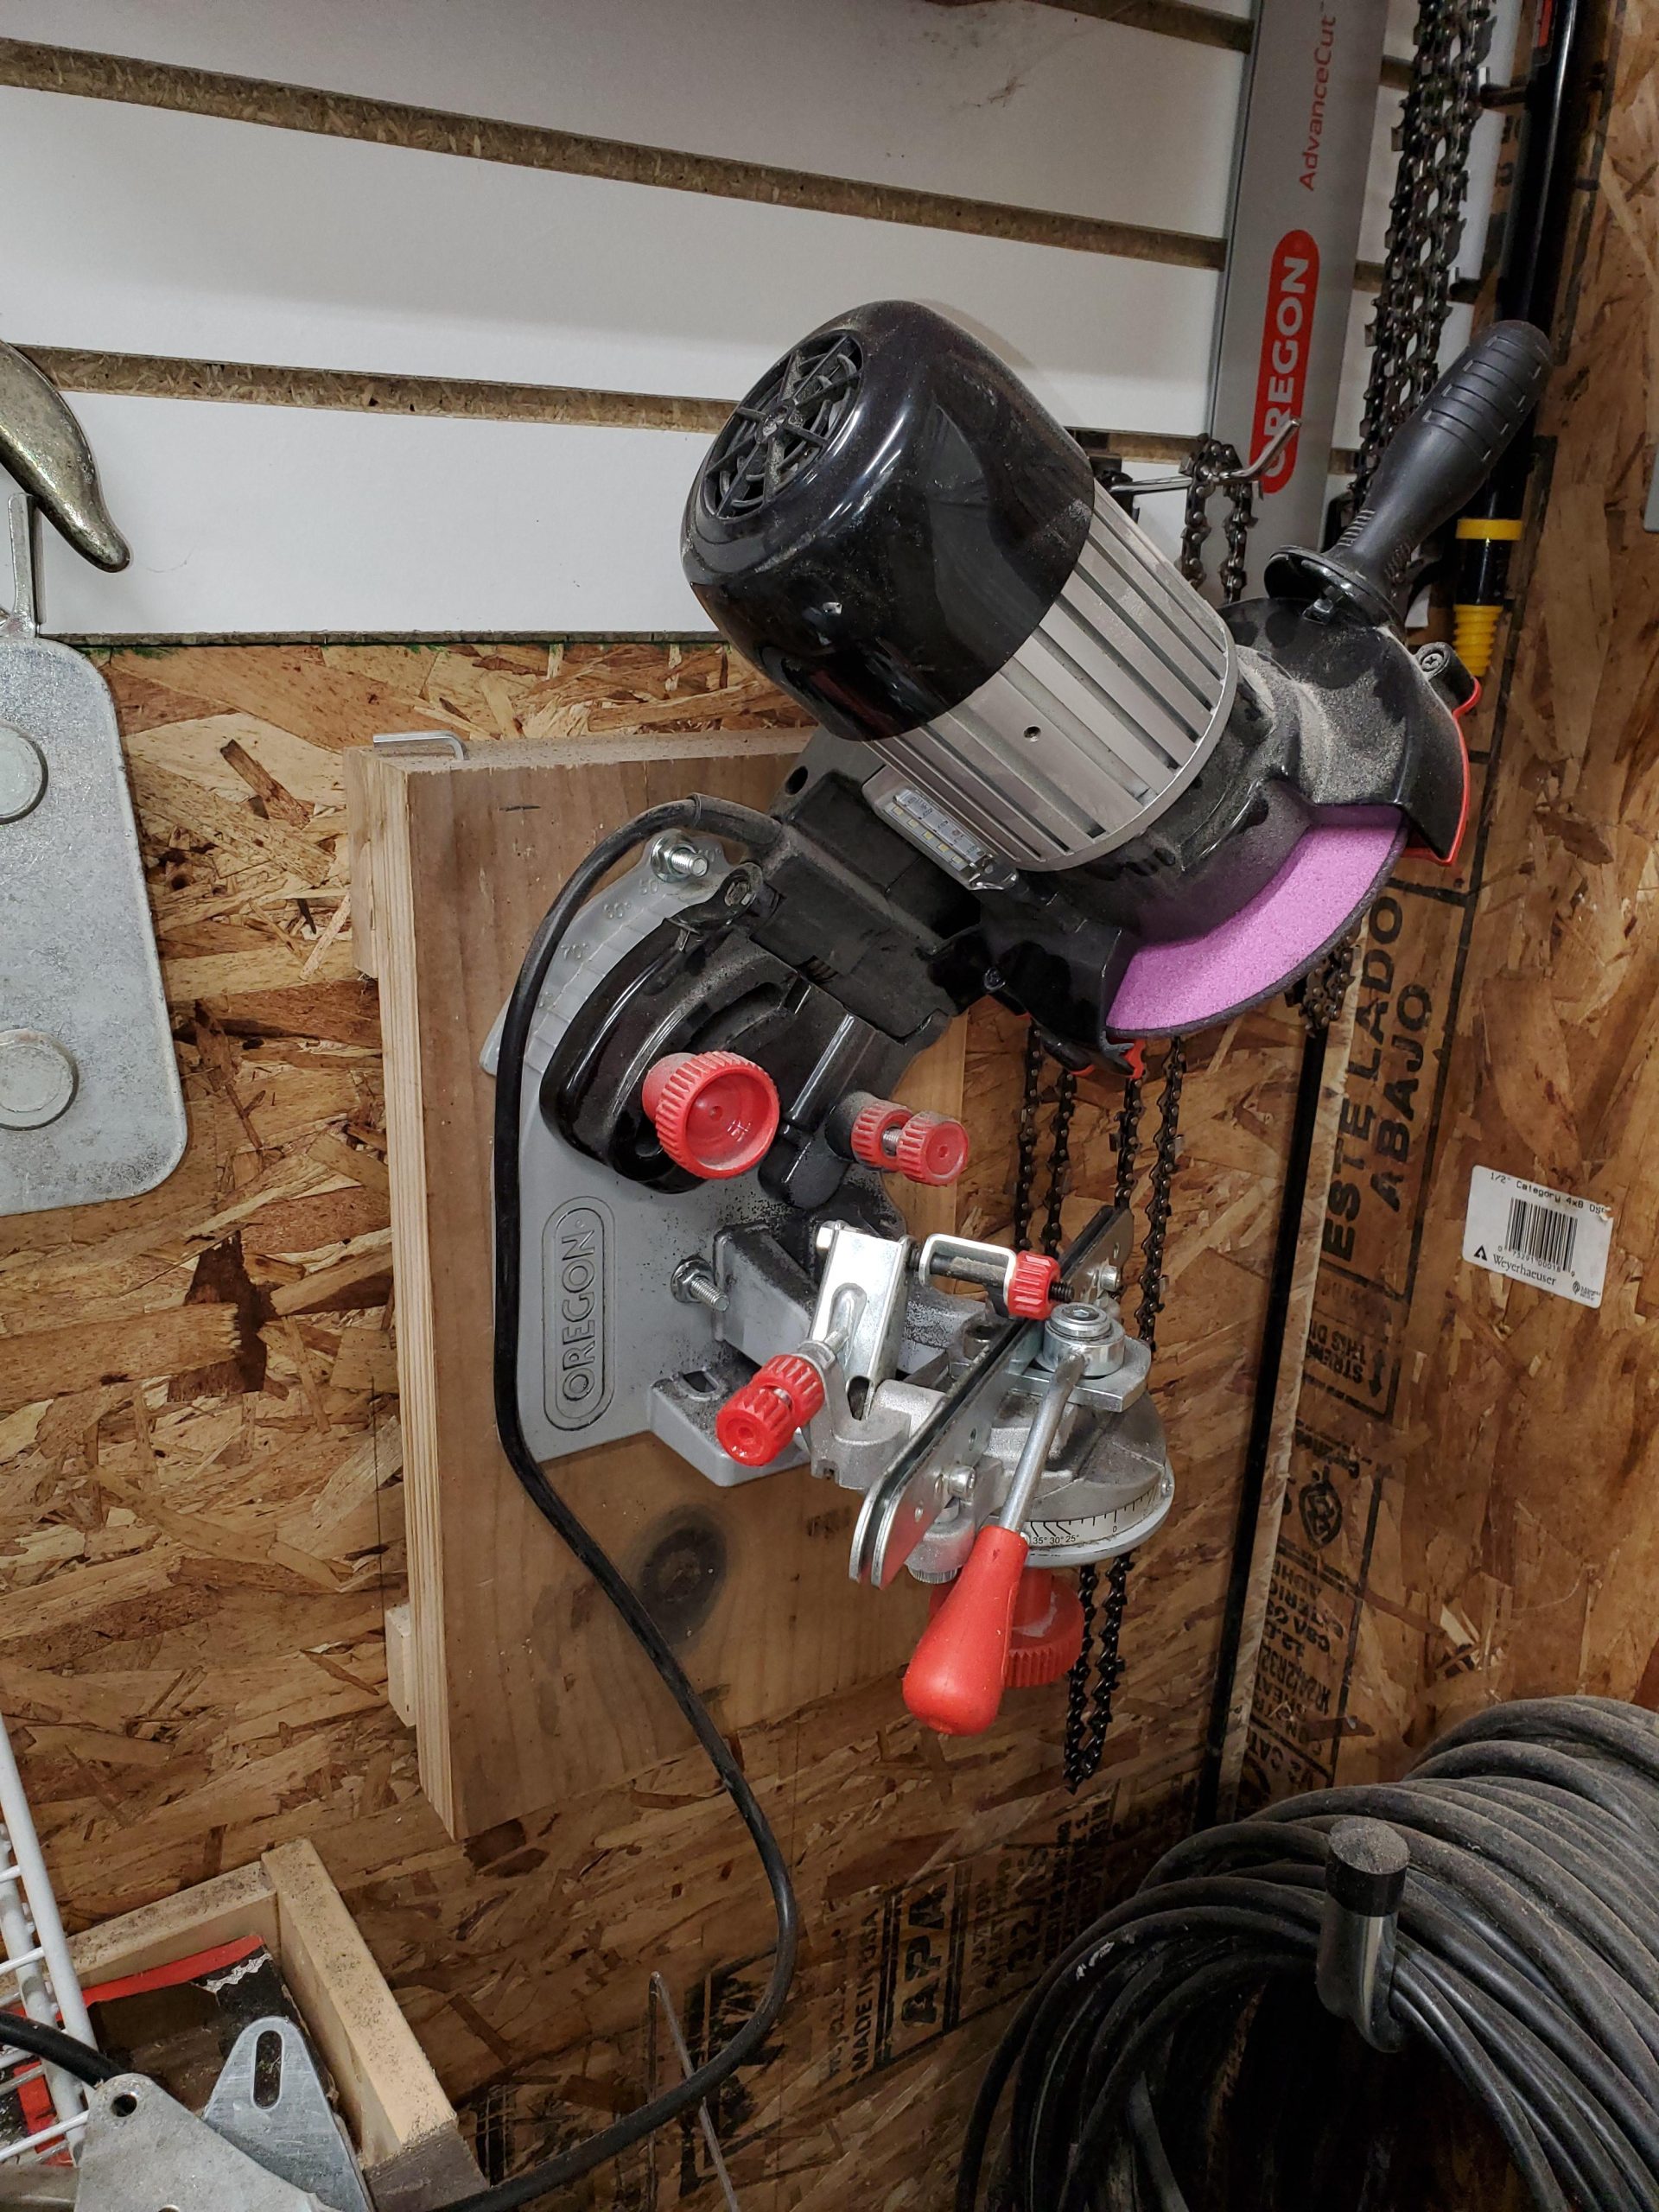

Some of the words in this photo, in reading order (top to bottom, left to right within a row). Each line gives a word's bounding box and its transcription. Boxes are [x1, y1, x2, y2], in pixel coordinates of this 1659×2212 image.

[1299, 15, 1336, 192] AdvanceCut
[1345, 896, 1403, 1081] LADO
[1370, 983, 1433, 1213] ABAJO
[1321, 1097, 1376, 1262] ESTE
[1516, 1179, 1561, 1204] Category
[561, 1230, 596, 1402] OREGON
[1492, 1252, 1557, 1287] Weyerhaeuser
[1033, 1536, 1047, 1545] 35°
[1049, 1535, 1065, 1545] 30°
[1065, 1534, 1080, 1543] 25°
[900, 1883, 948, 2028] APA
[850, 1998, 874, 2073] MADE
